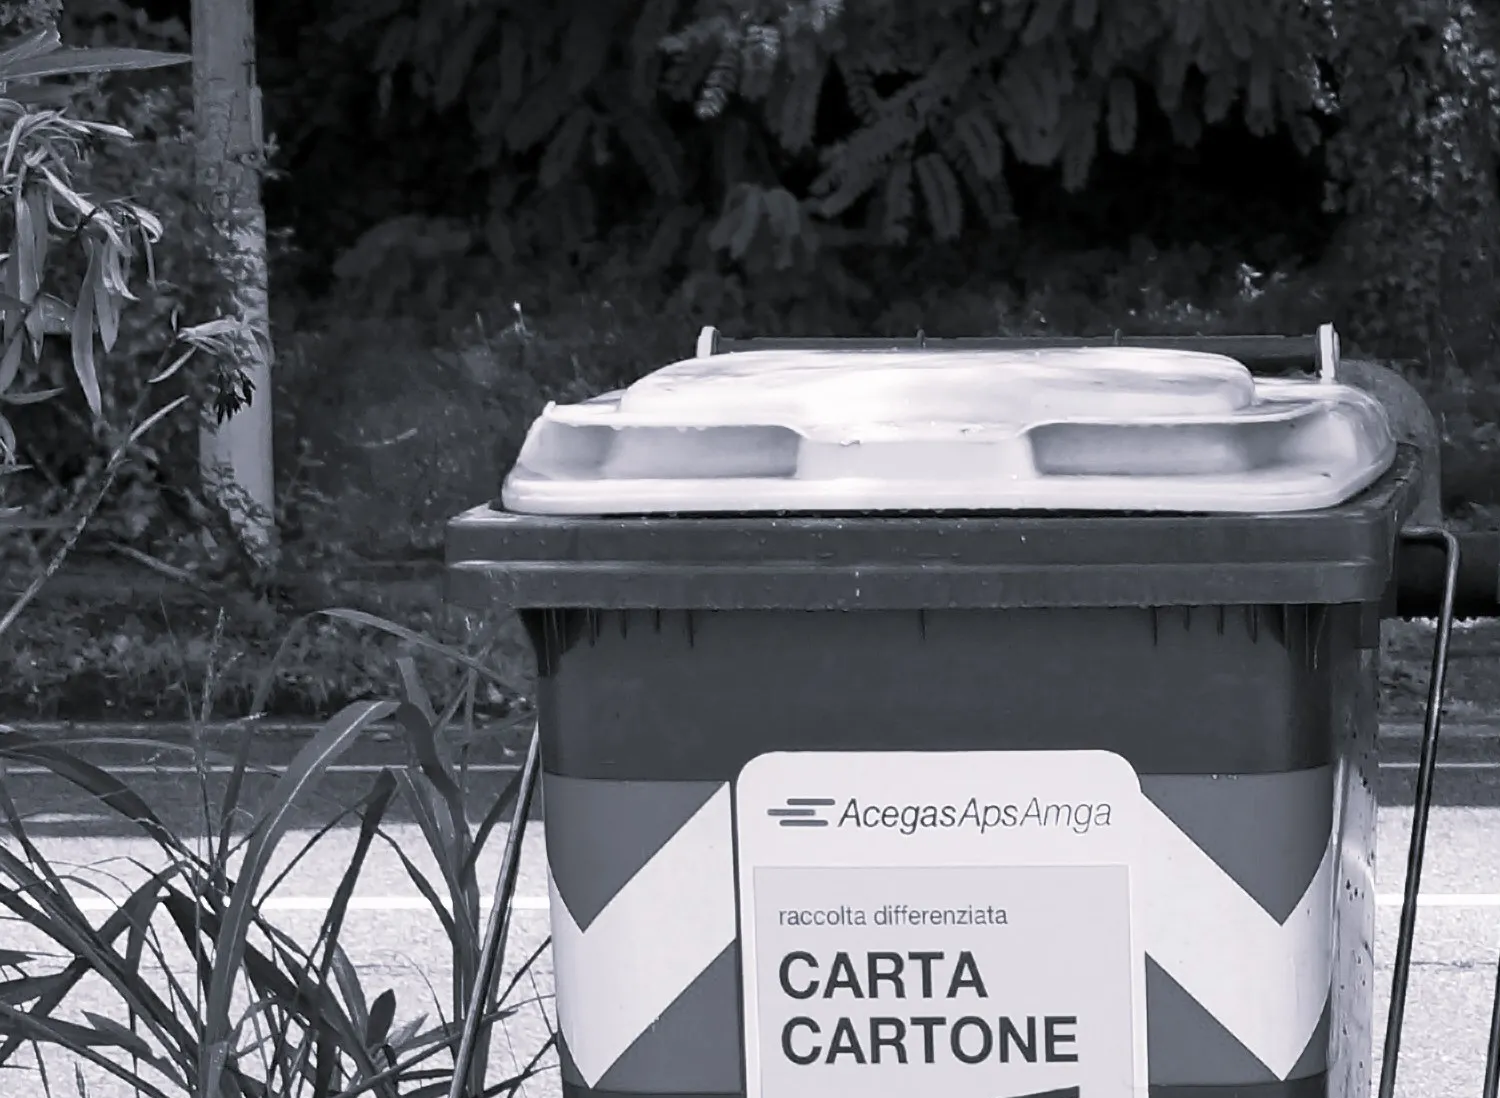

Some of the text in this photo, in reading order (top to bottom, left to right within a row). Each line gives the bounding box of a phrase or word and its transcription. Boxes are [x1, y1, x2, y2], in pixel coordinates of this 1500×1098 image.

[837, 797, 1112, 835] AcegasApsAmga
[779, 905, 1008, 925] raccolta differenziata
[779, 950, 989, 1000] CARTA
[781, 1015, 1079, 1064] CARTONE
